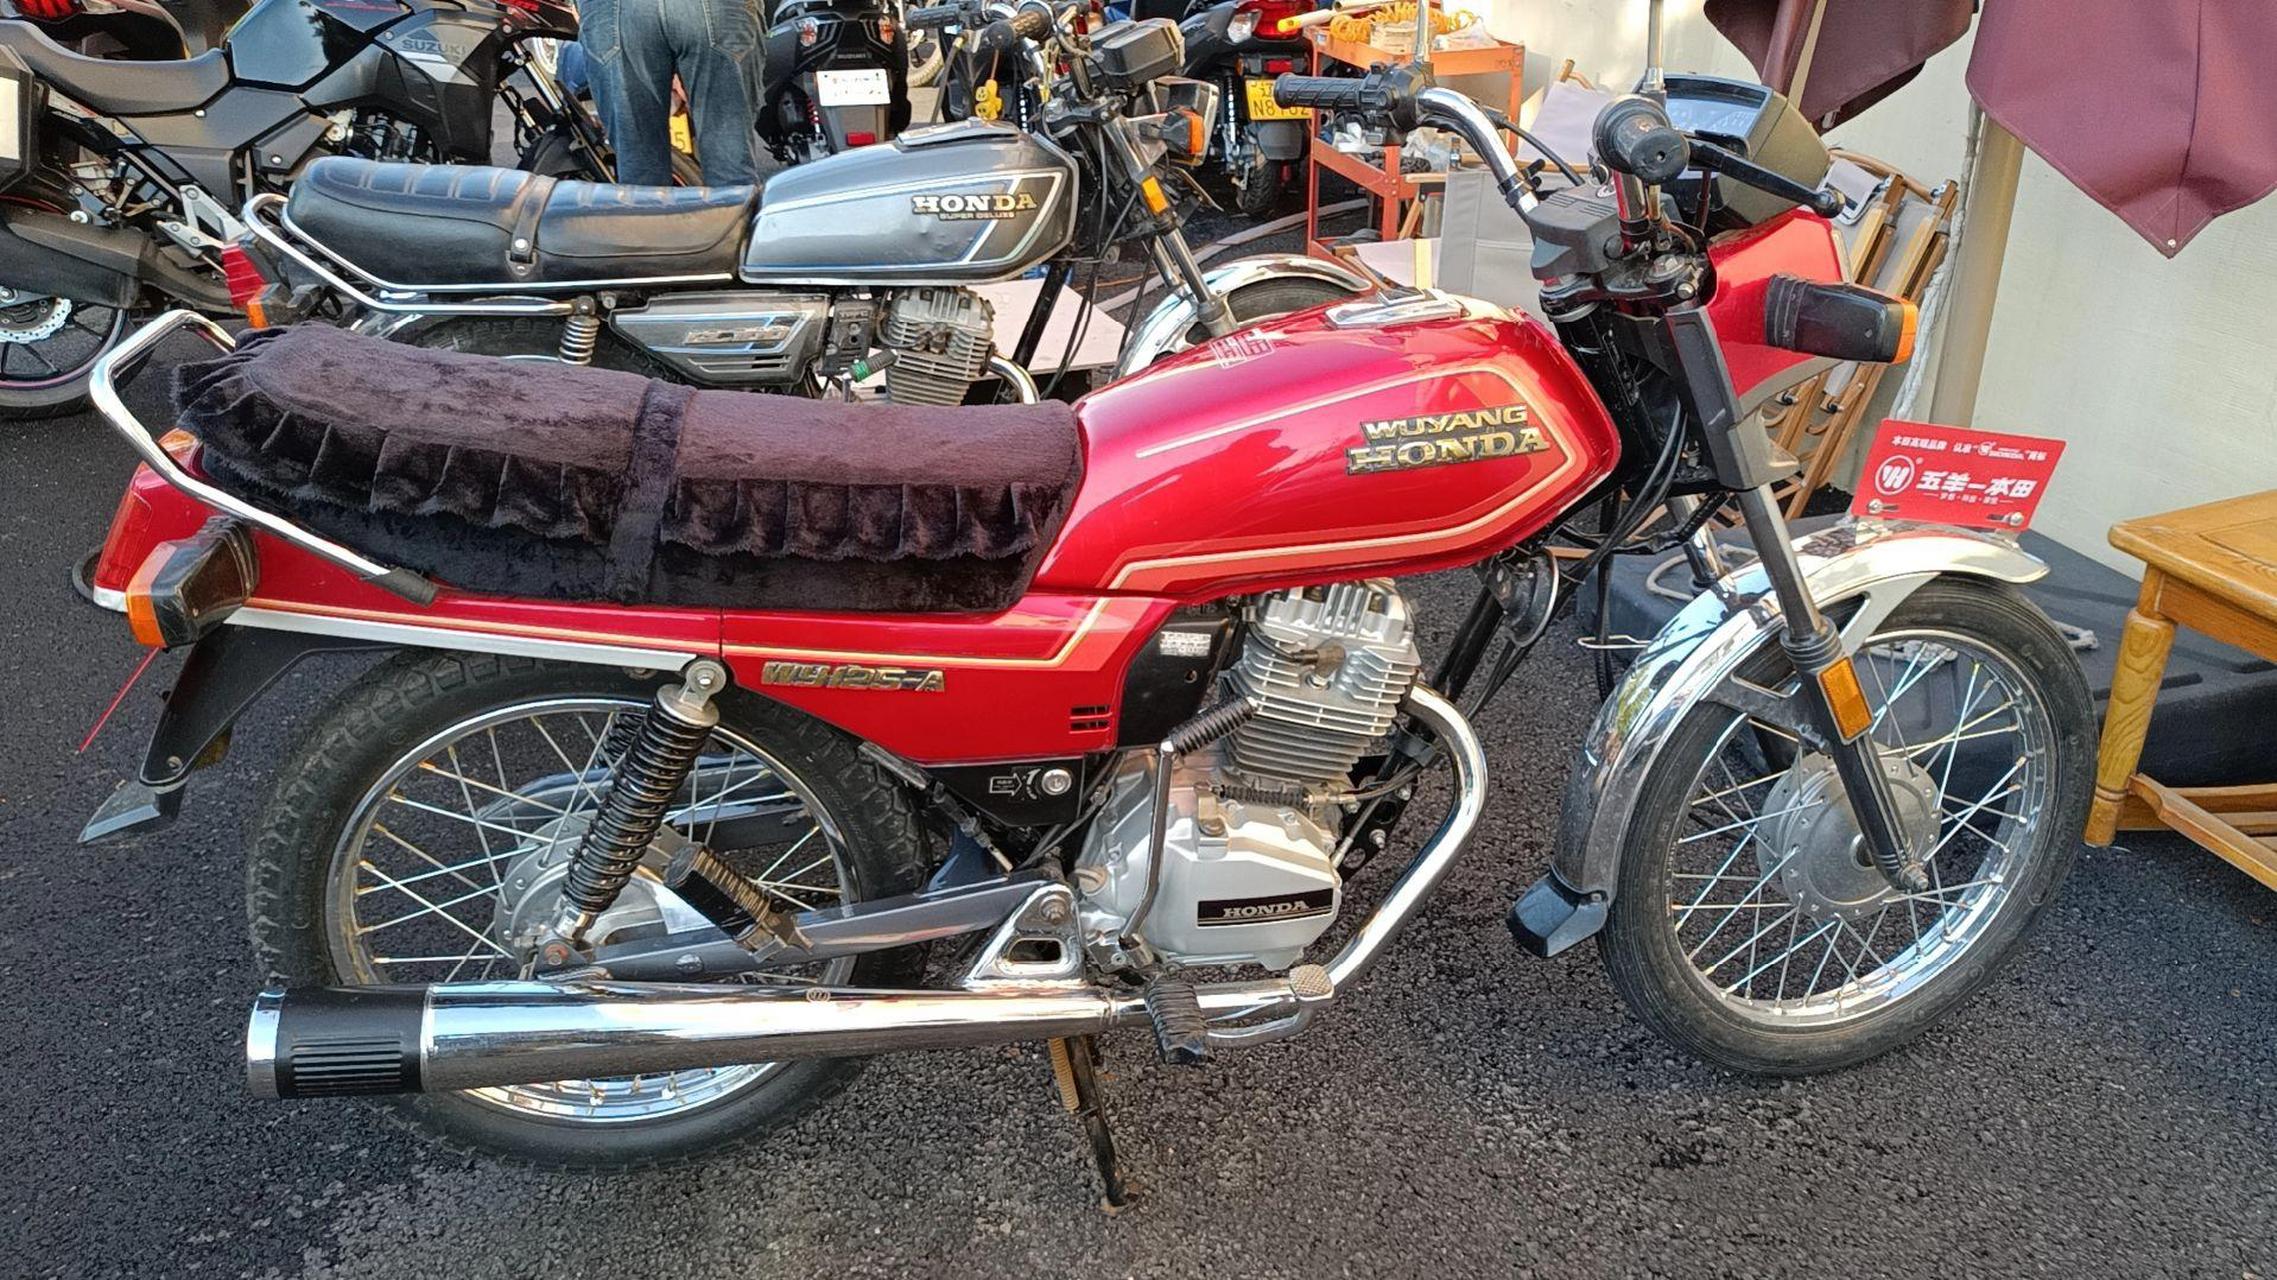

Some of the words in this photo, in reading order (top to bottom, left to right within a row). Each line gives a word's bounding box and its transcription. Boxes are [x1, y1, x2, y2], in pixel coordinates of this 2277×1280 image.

[402, 40, 466, 55] SUZUKI
[912, 194, 1037, 213] HONDA
[1364, 405, 1528, 440] WUYANG
[1349, 427, 1550, 471] HONDA
[1223, 900, 1310, 918] HONDA
